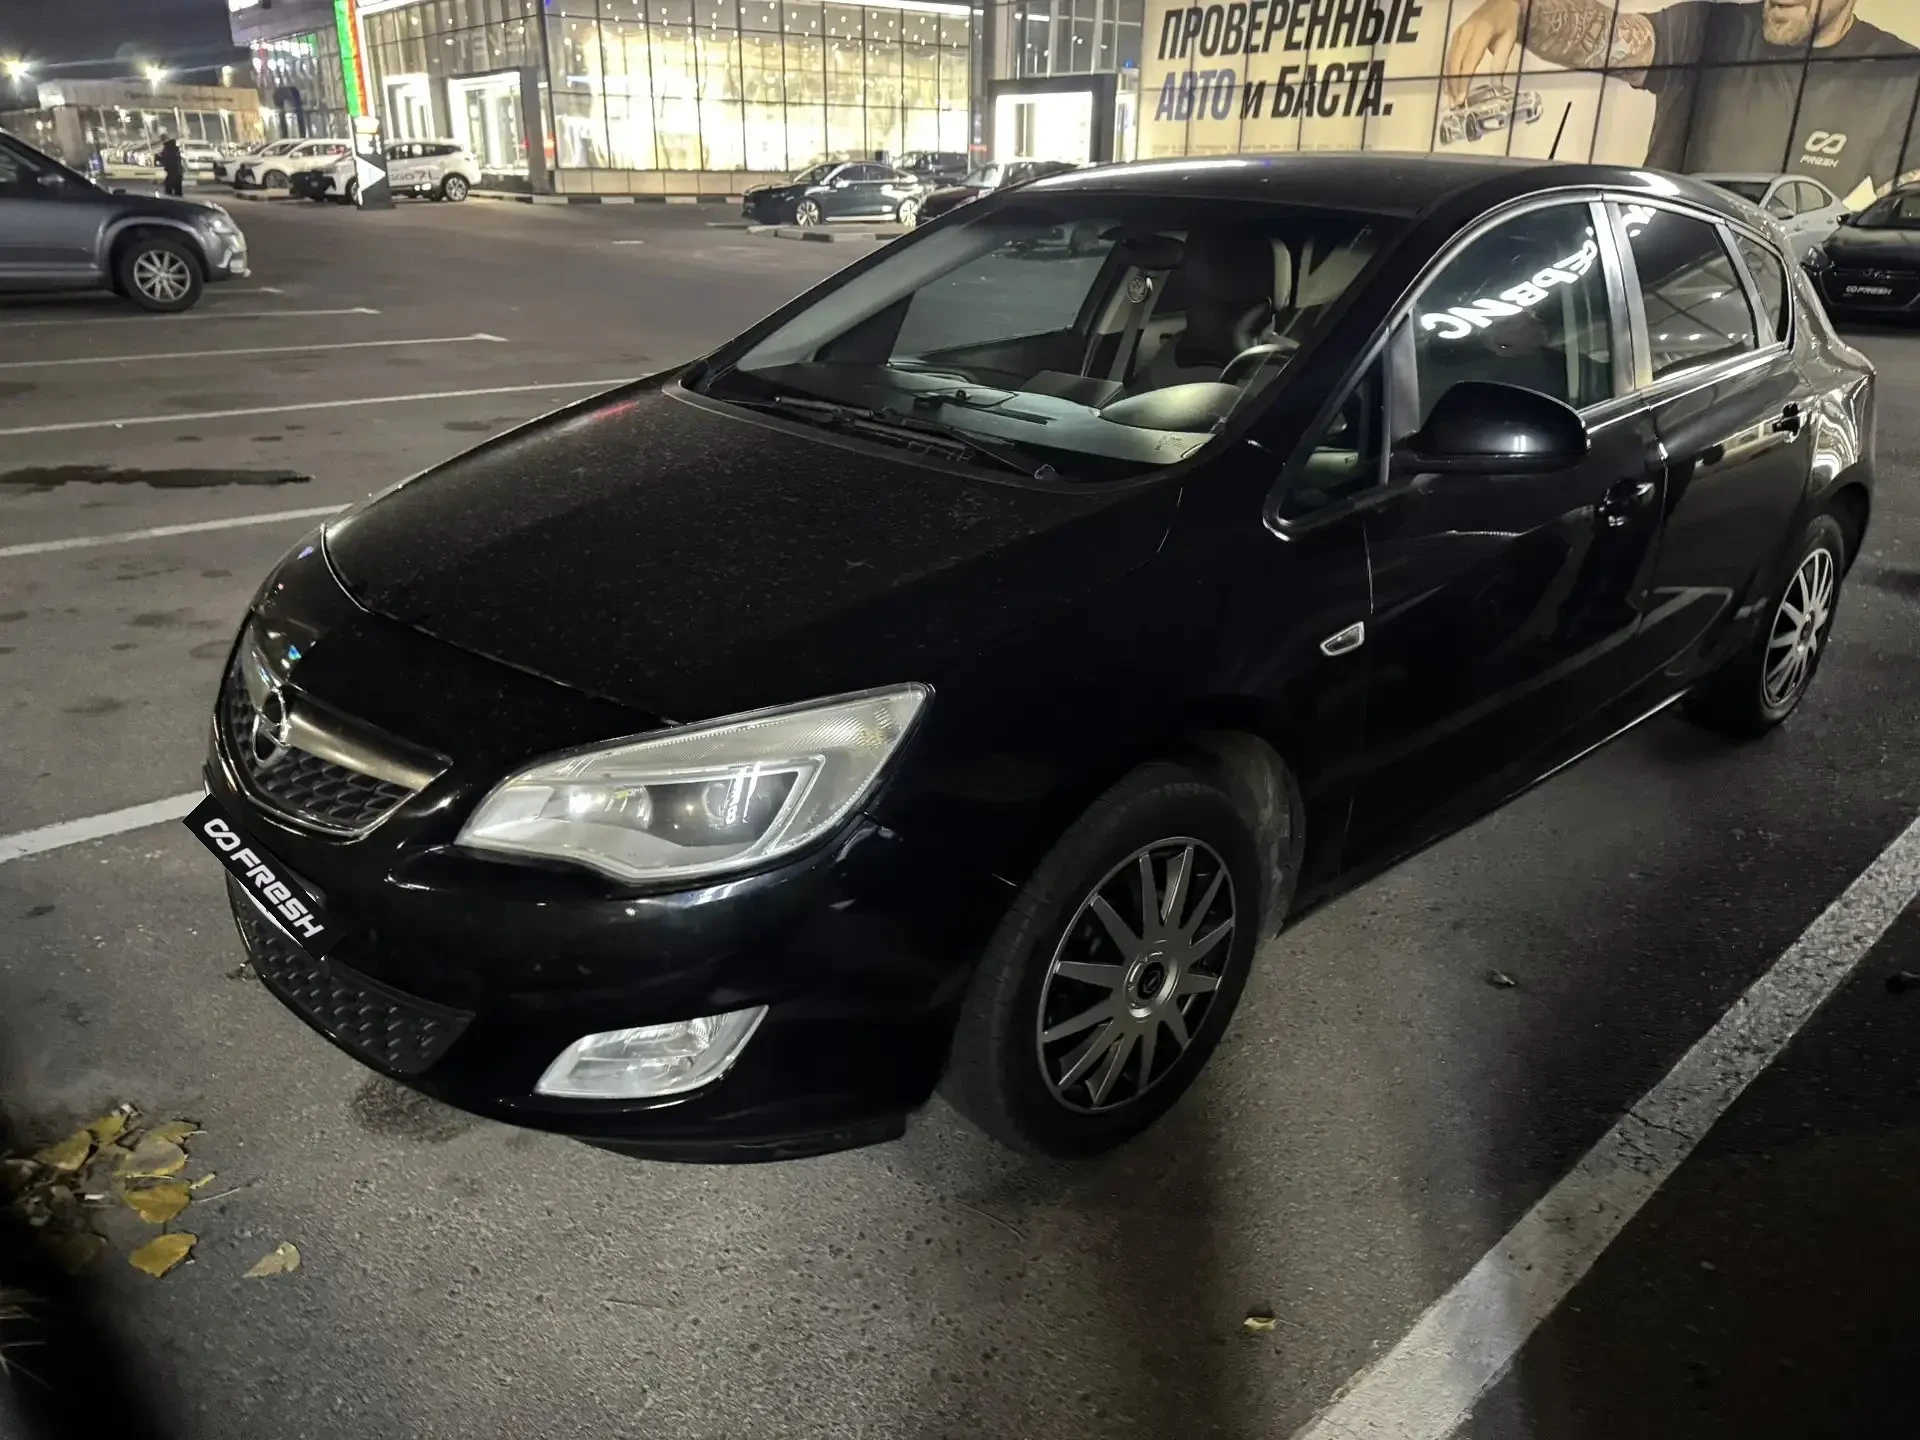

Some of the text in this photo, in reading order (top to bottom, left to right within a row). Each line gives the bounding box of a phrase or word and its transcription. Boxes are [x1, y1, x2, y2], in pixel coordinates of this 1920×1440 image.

[1157, 0, 1423, 60] ПРОВЕРЕННЫЕ
[1154, 60, 1394, 121] АВТО и БАСТА.
